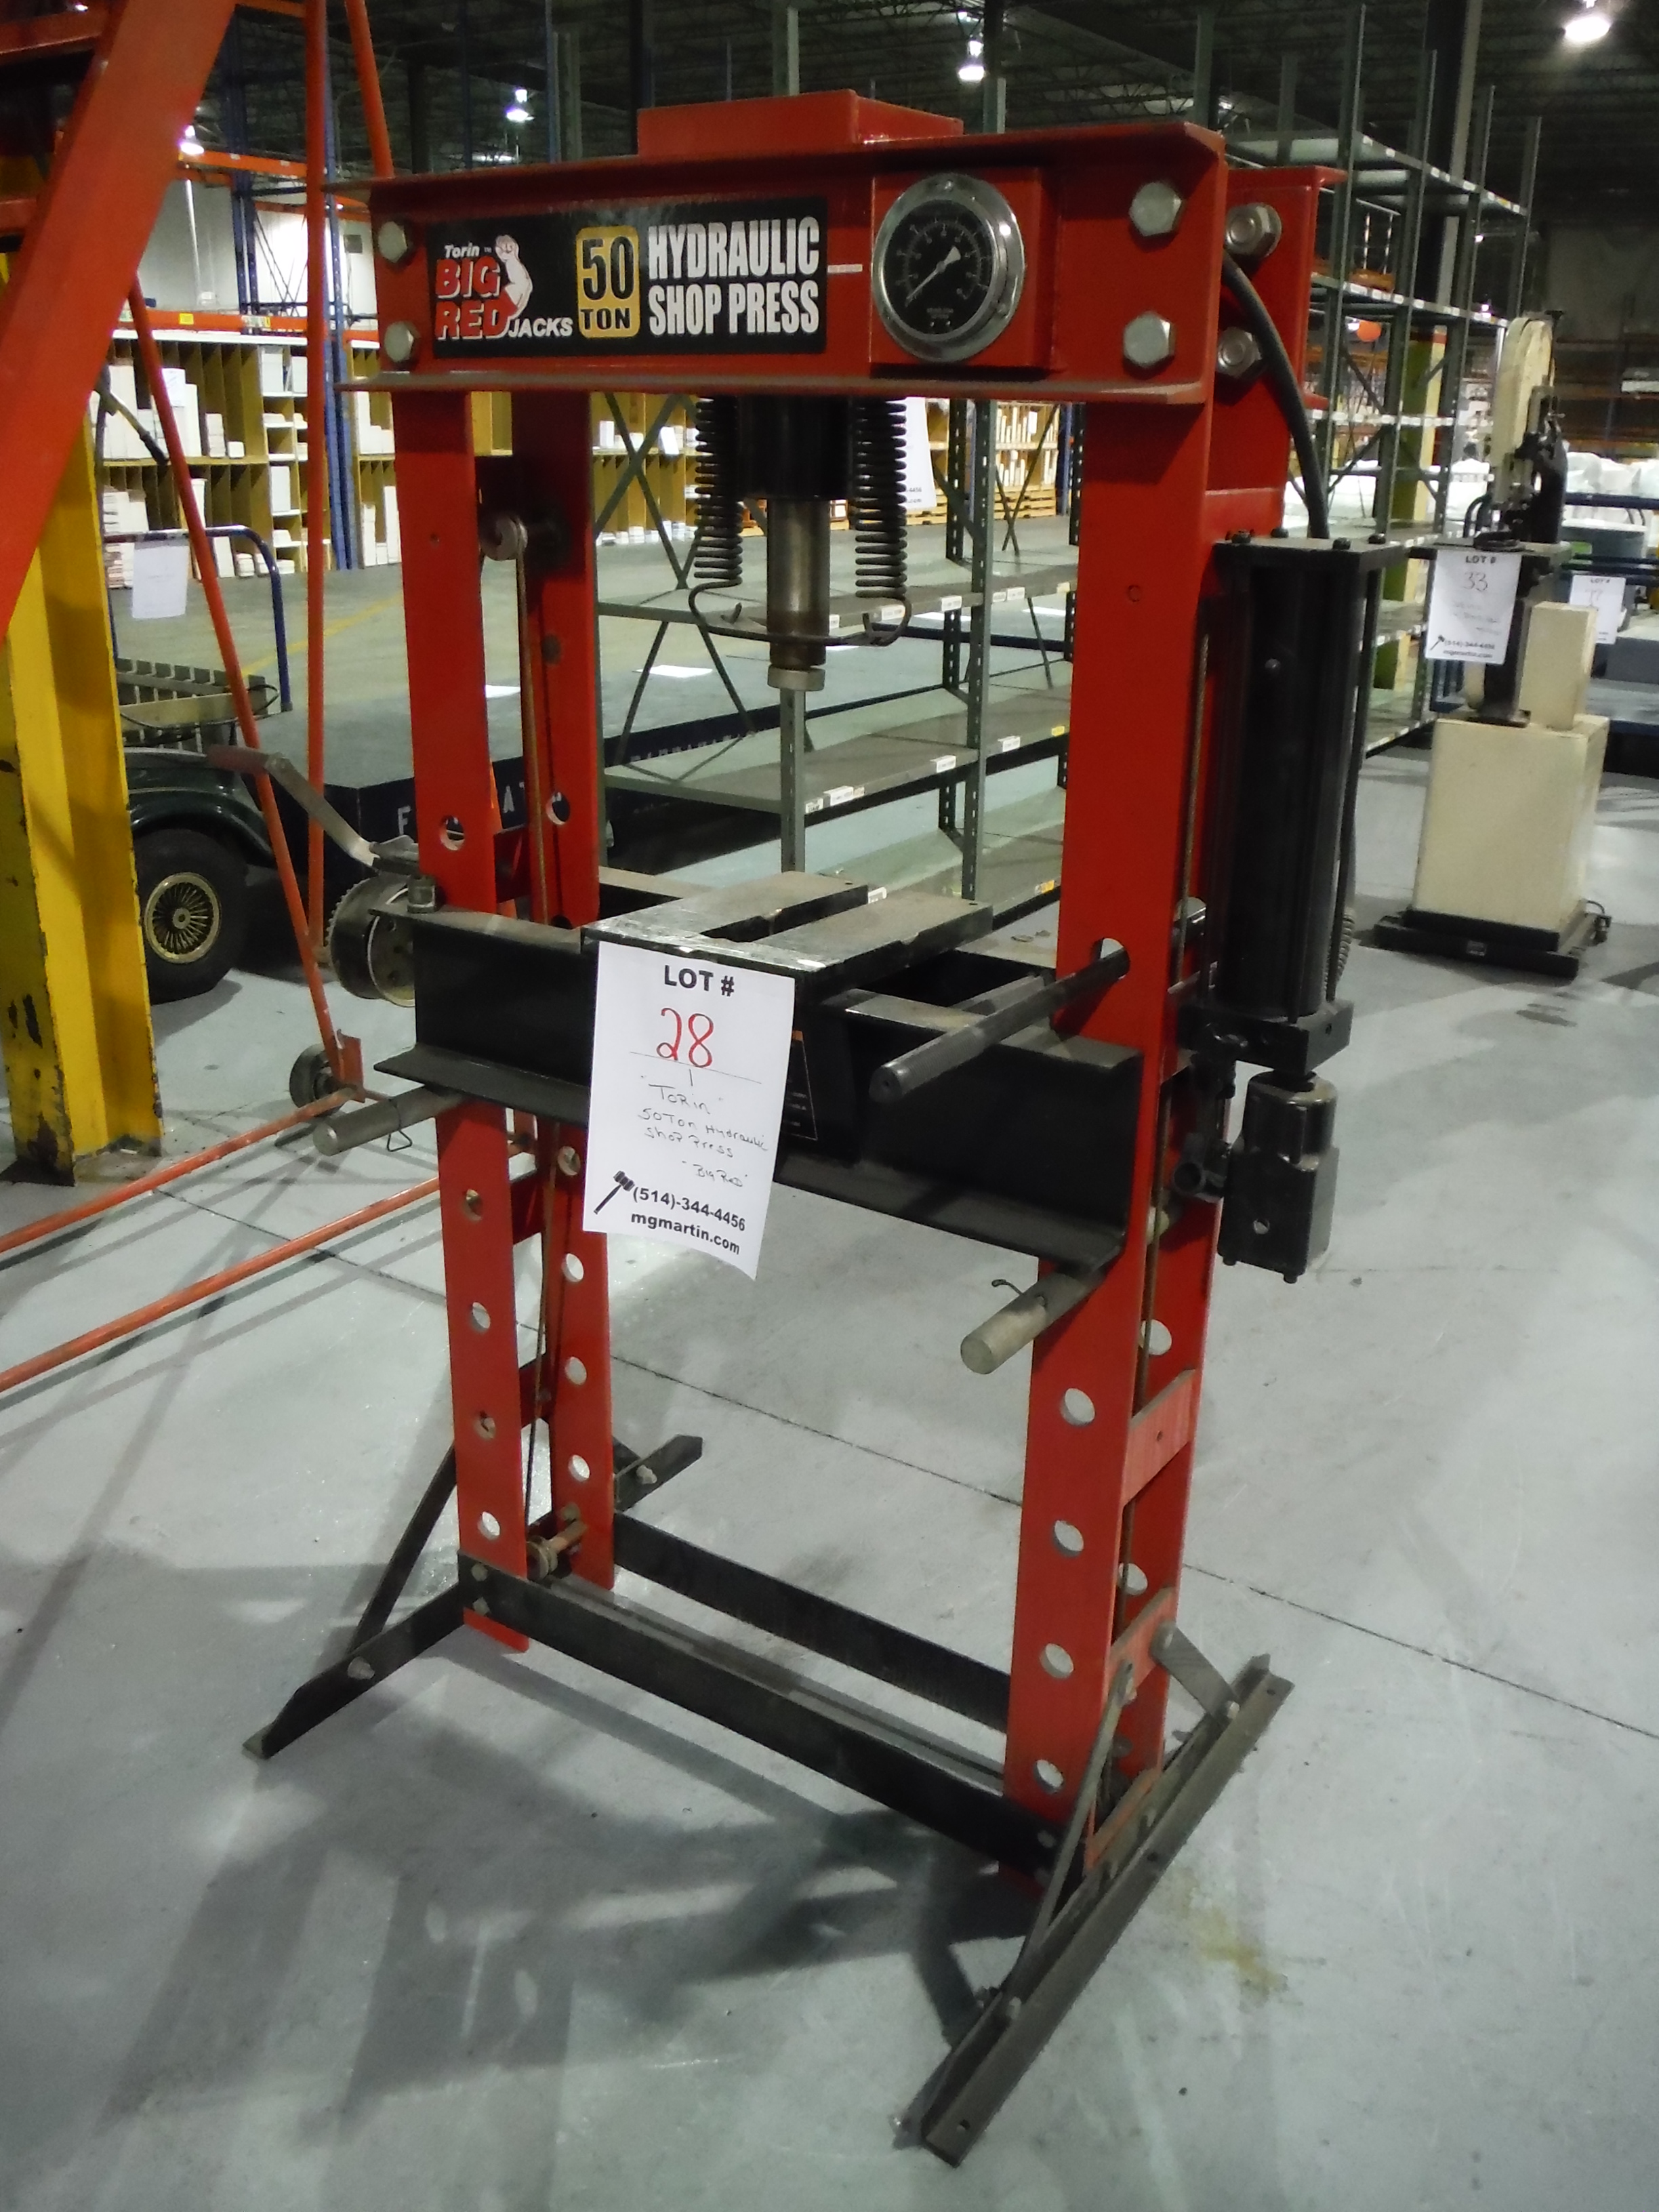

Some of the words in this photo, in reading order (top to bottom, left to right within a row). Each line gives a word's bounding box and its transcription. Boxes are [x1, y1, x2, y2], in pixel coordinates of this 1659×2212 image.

[444, 243, 480, 258] Torin
[581, 236, 635, 302] 50
[648, 216, 820, 281] HYDRAULIC
[435, 255, 501, 298] BIG
[434, 295, 516, 340] RED
[508, 317, 574, 337] JACKS
[581, 307, 631, 331] TON
[649, 283, 722, 336] SHOP
[729, 281, 820, 334] PRESS
[1466, 554, 1487, 565] LOT
[1463, 571, 1488, 592] 33
[663, 964, 714, 991] LOT
[720, 975, 735, 997] #
[656, 1007, 714, 1069] 28
[632, 1186, 745, 1232] (514)-344-4456
[631, 1213, 741, 1255] mgmartin.com
